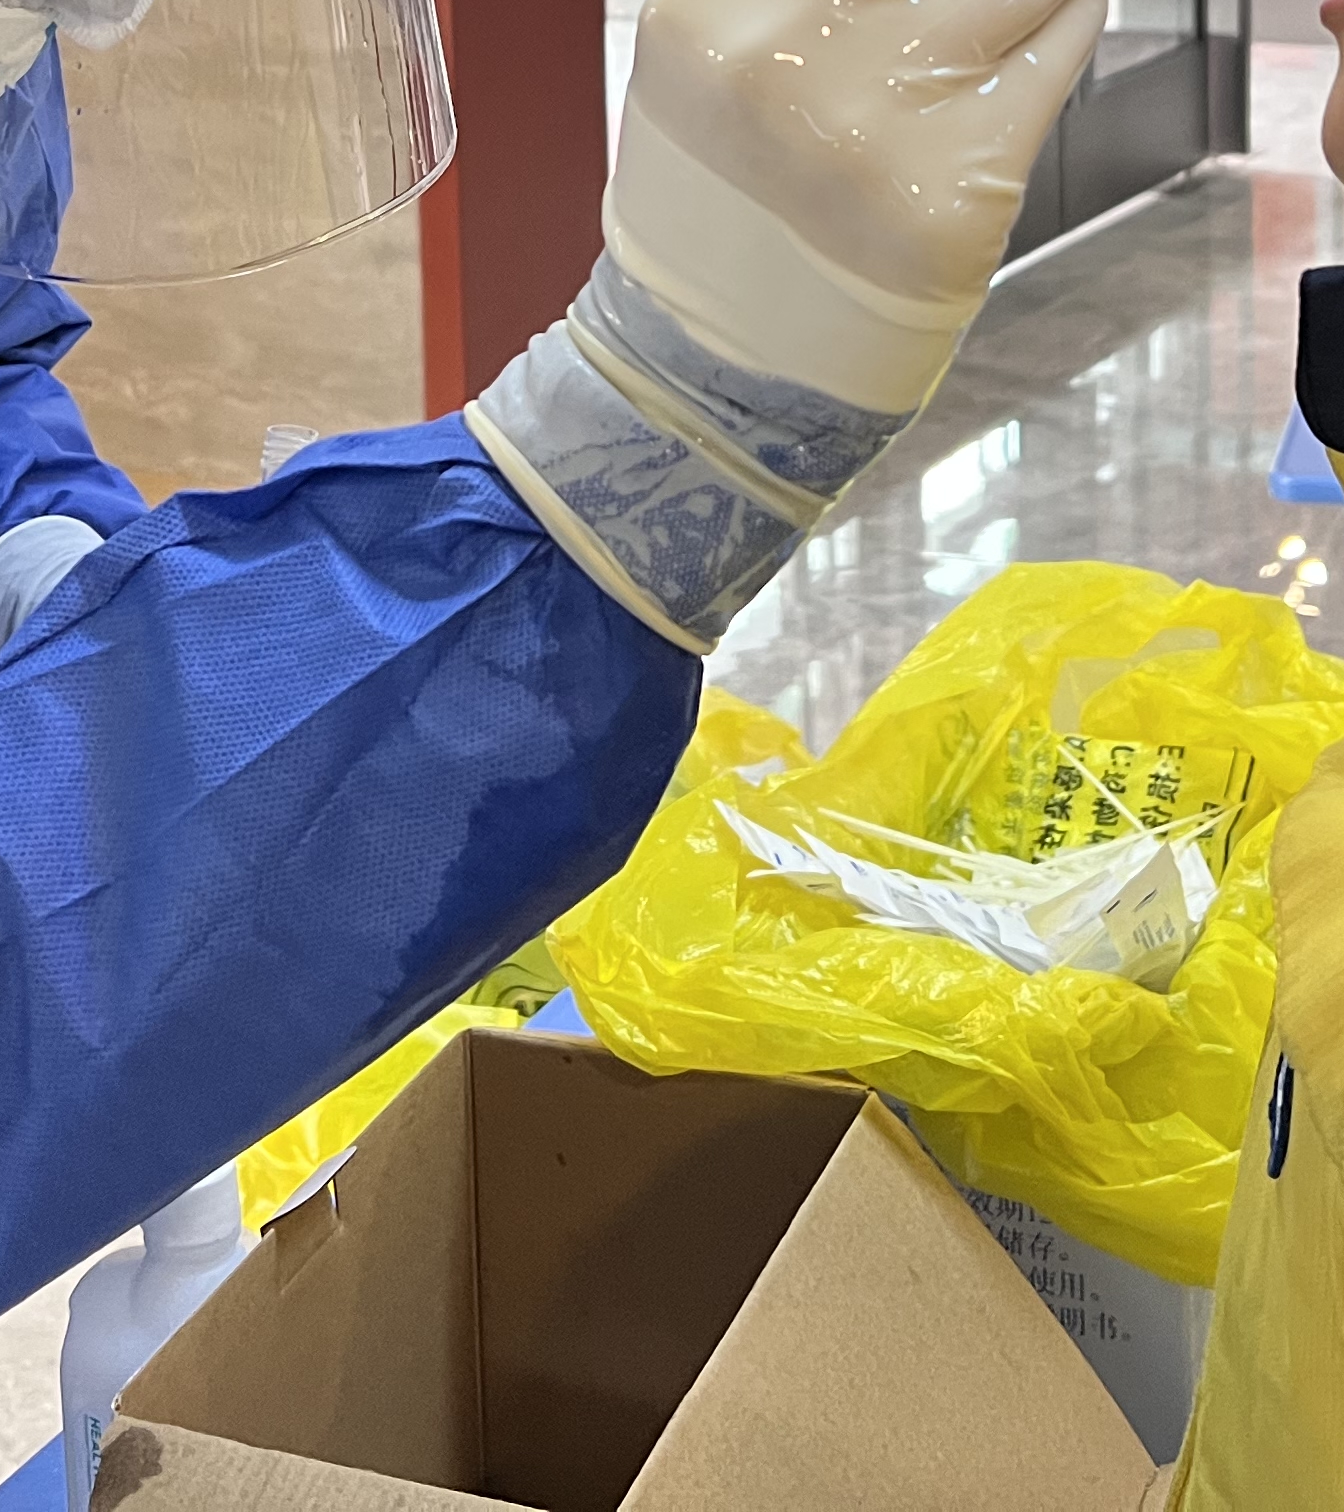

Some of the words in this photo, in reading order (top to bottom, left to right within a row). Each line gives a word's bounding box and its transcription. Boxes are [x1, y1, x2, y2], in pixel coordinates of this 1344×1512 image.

[984, 1224, 1069, 1262] 储存。
[1047, 1303, 1132, 1340] 明书。
[89, 1415, 102, 1476] HEAL
